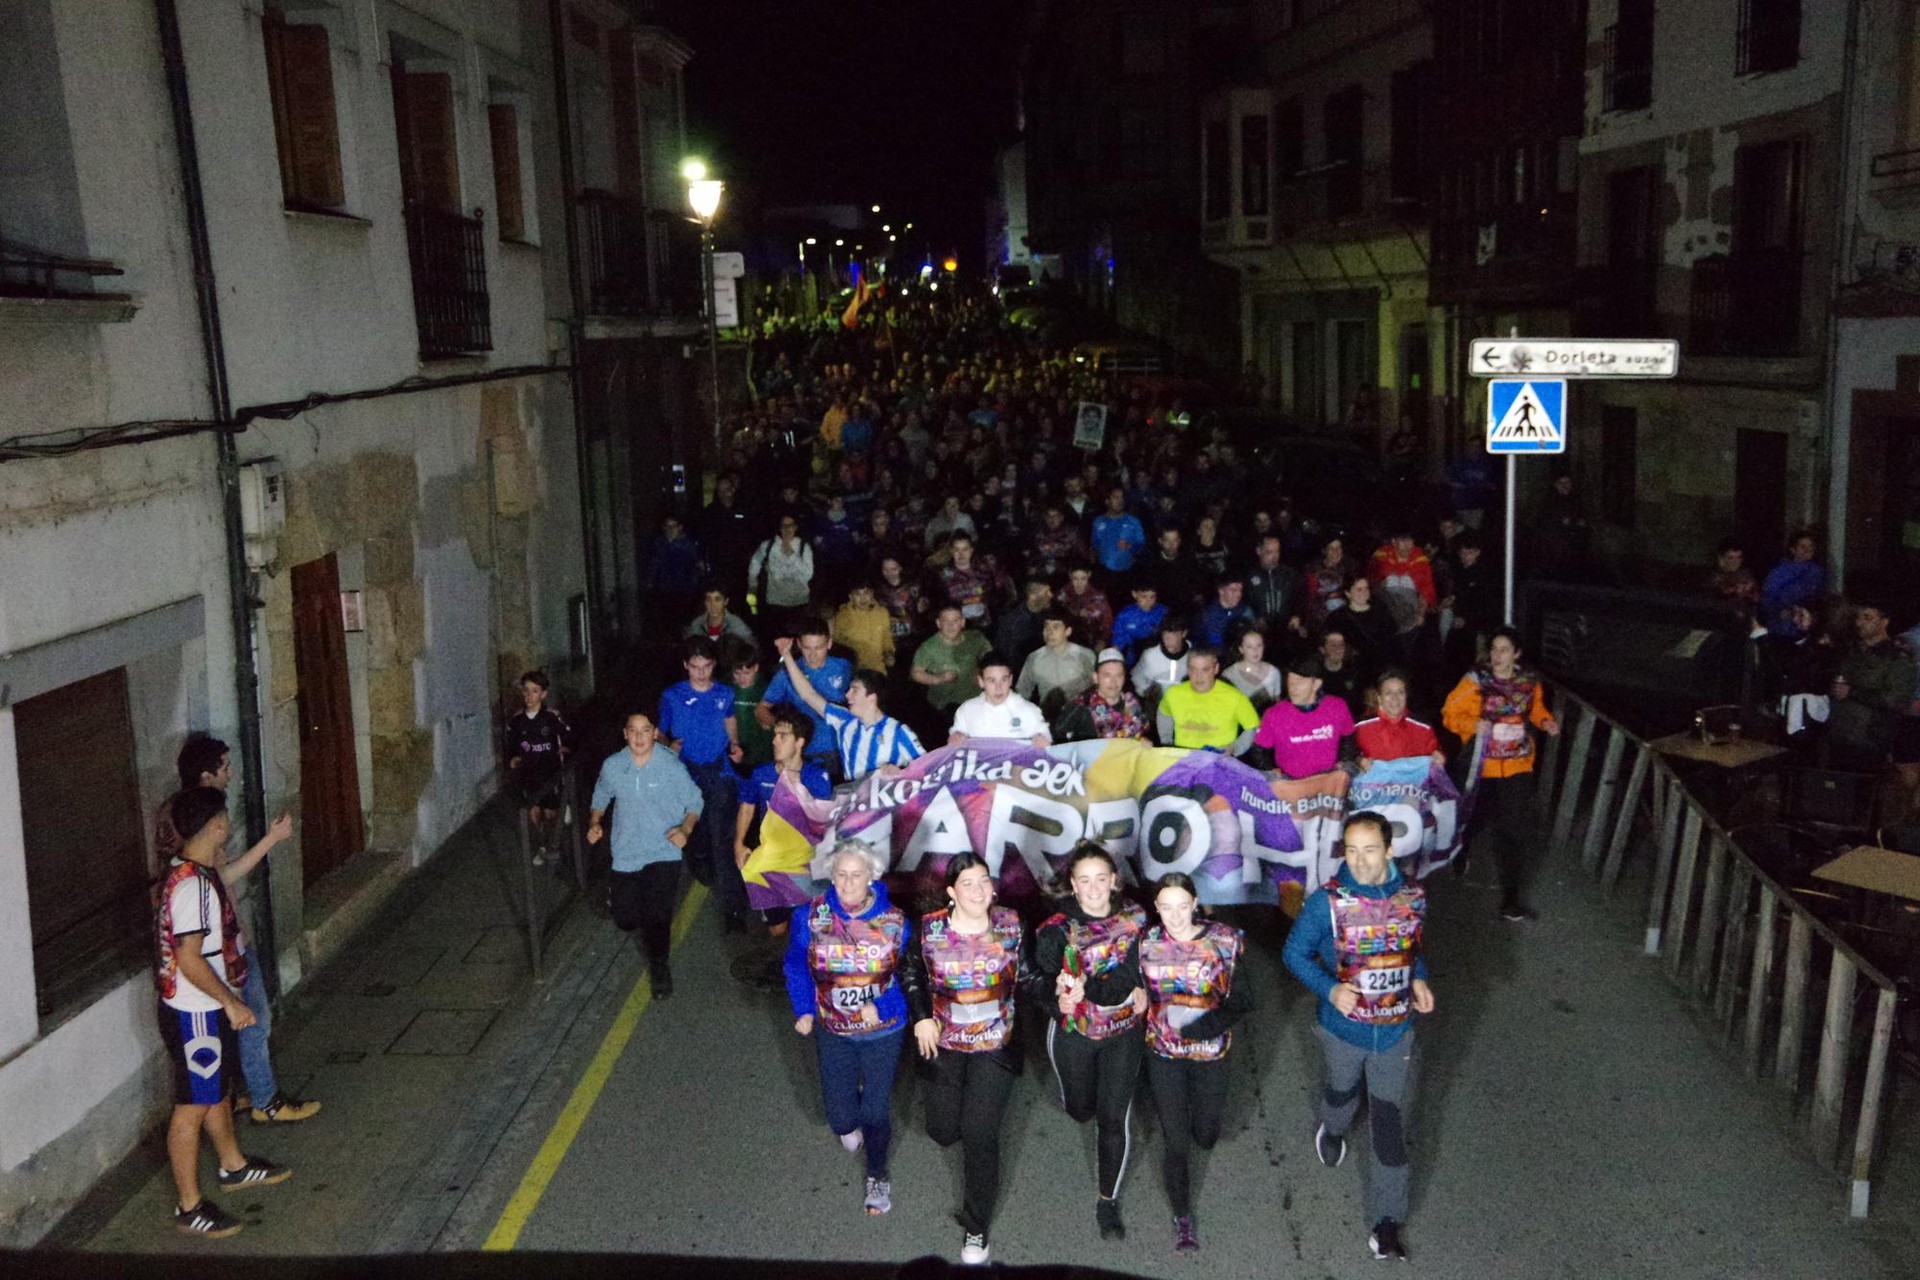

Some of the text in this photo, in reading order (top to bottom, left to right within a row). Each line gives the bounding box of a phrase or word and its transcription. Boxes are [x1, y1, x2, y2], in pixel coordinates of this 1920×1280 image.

[1546, 350, 1616, 365] Dorleta
[1369, 969, 1404, 990] 2244
[840, 984, 875, 1007] 2244
